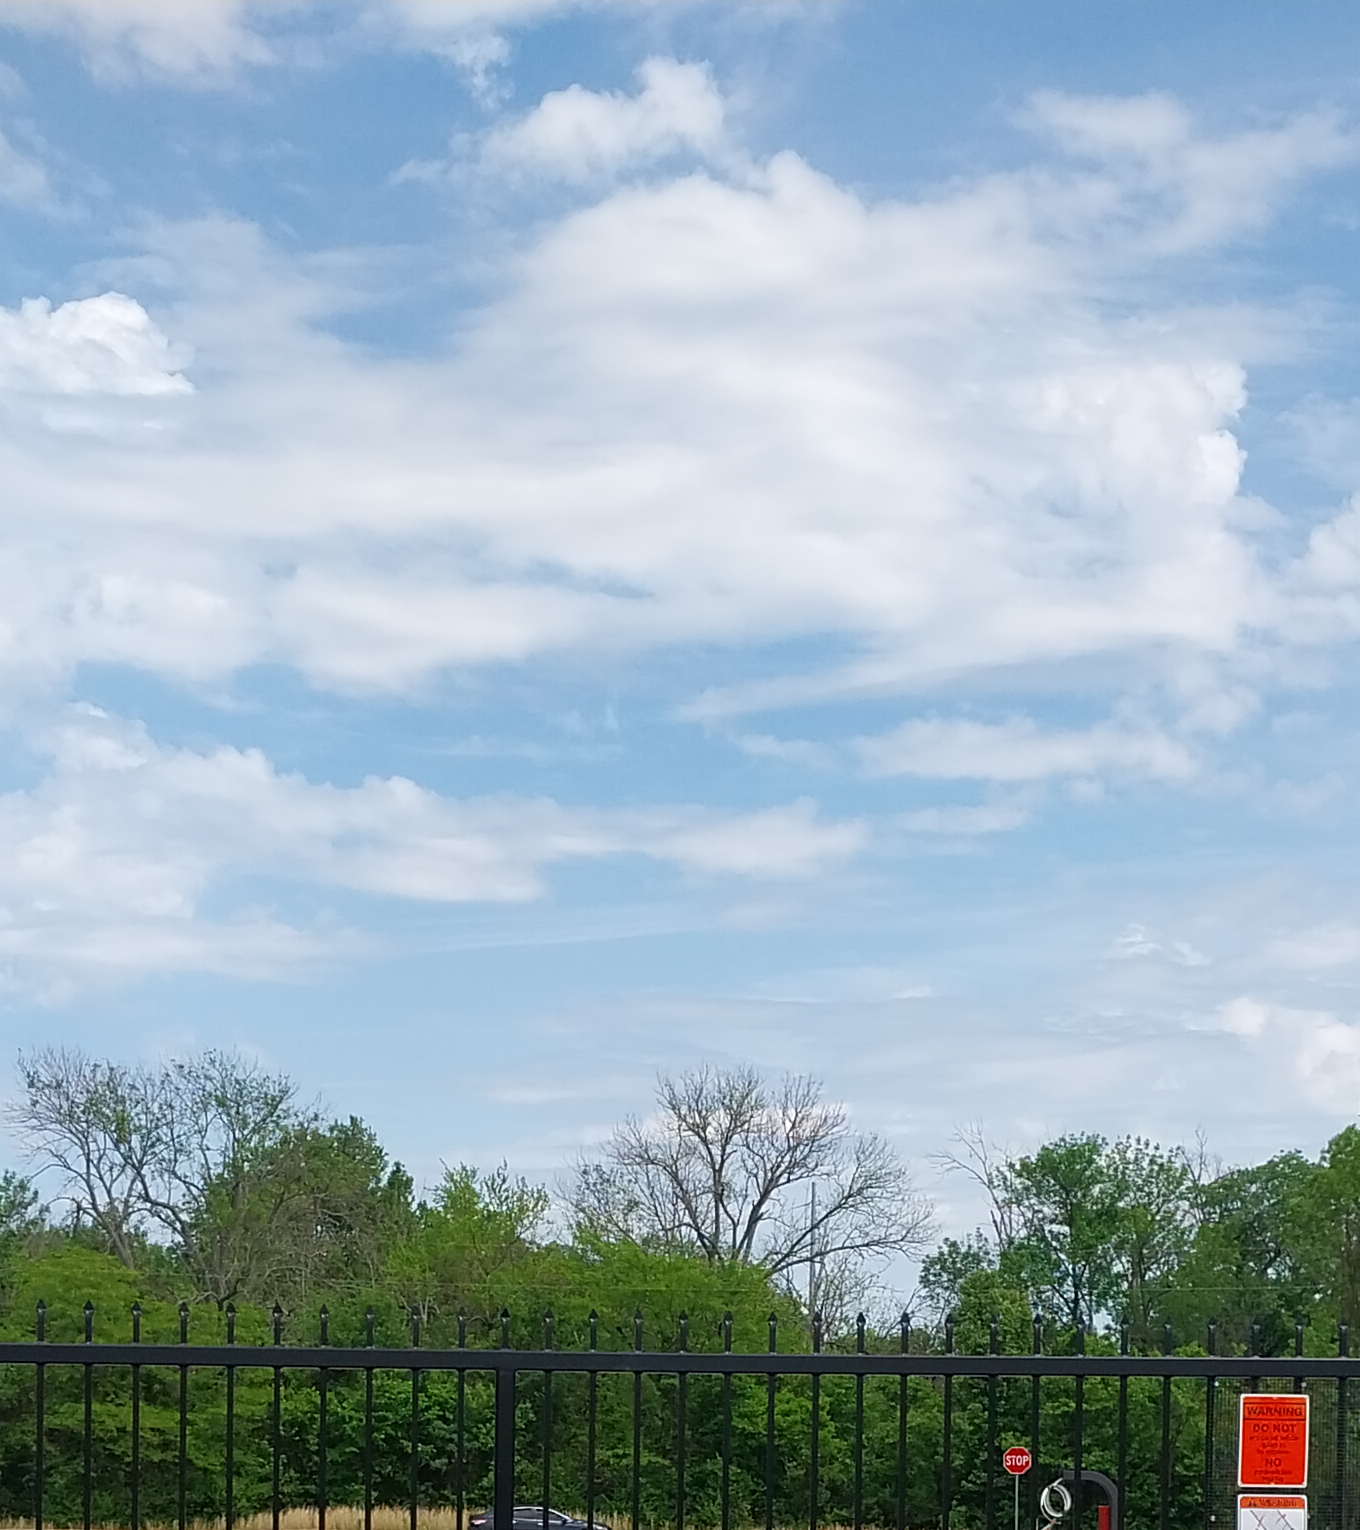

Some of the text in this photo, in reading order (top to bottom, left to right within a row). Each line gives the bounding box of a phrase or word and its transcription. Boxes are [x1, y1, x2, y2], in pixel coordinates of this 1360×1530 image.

[1247, 1406, 1302, 1417] WARNING
[1253, 1423, 1296, 1433] DO NOT
[1005, 1455, 1029, 1466] STOP
[1265, 1458, 1282, 1467] NO
[1259, 1498, 1297, 1507] WARNING
